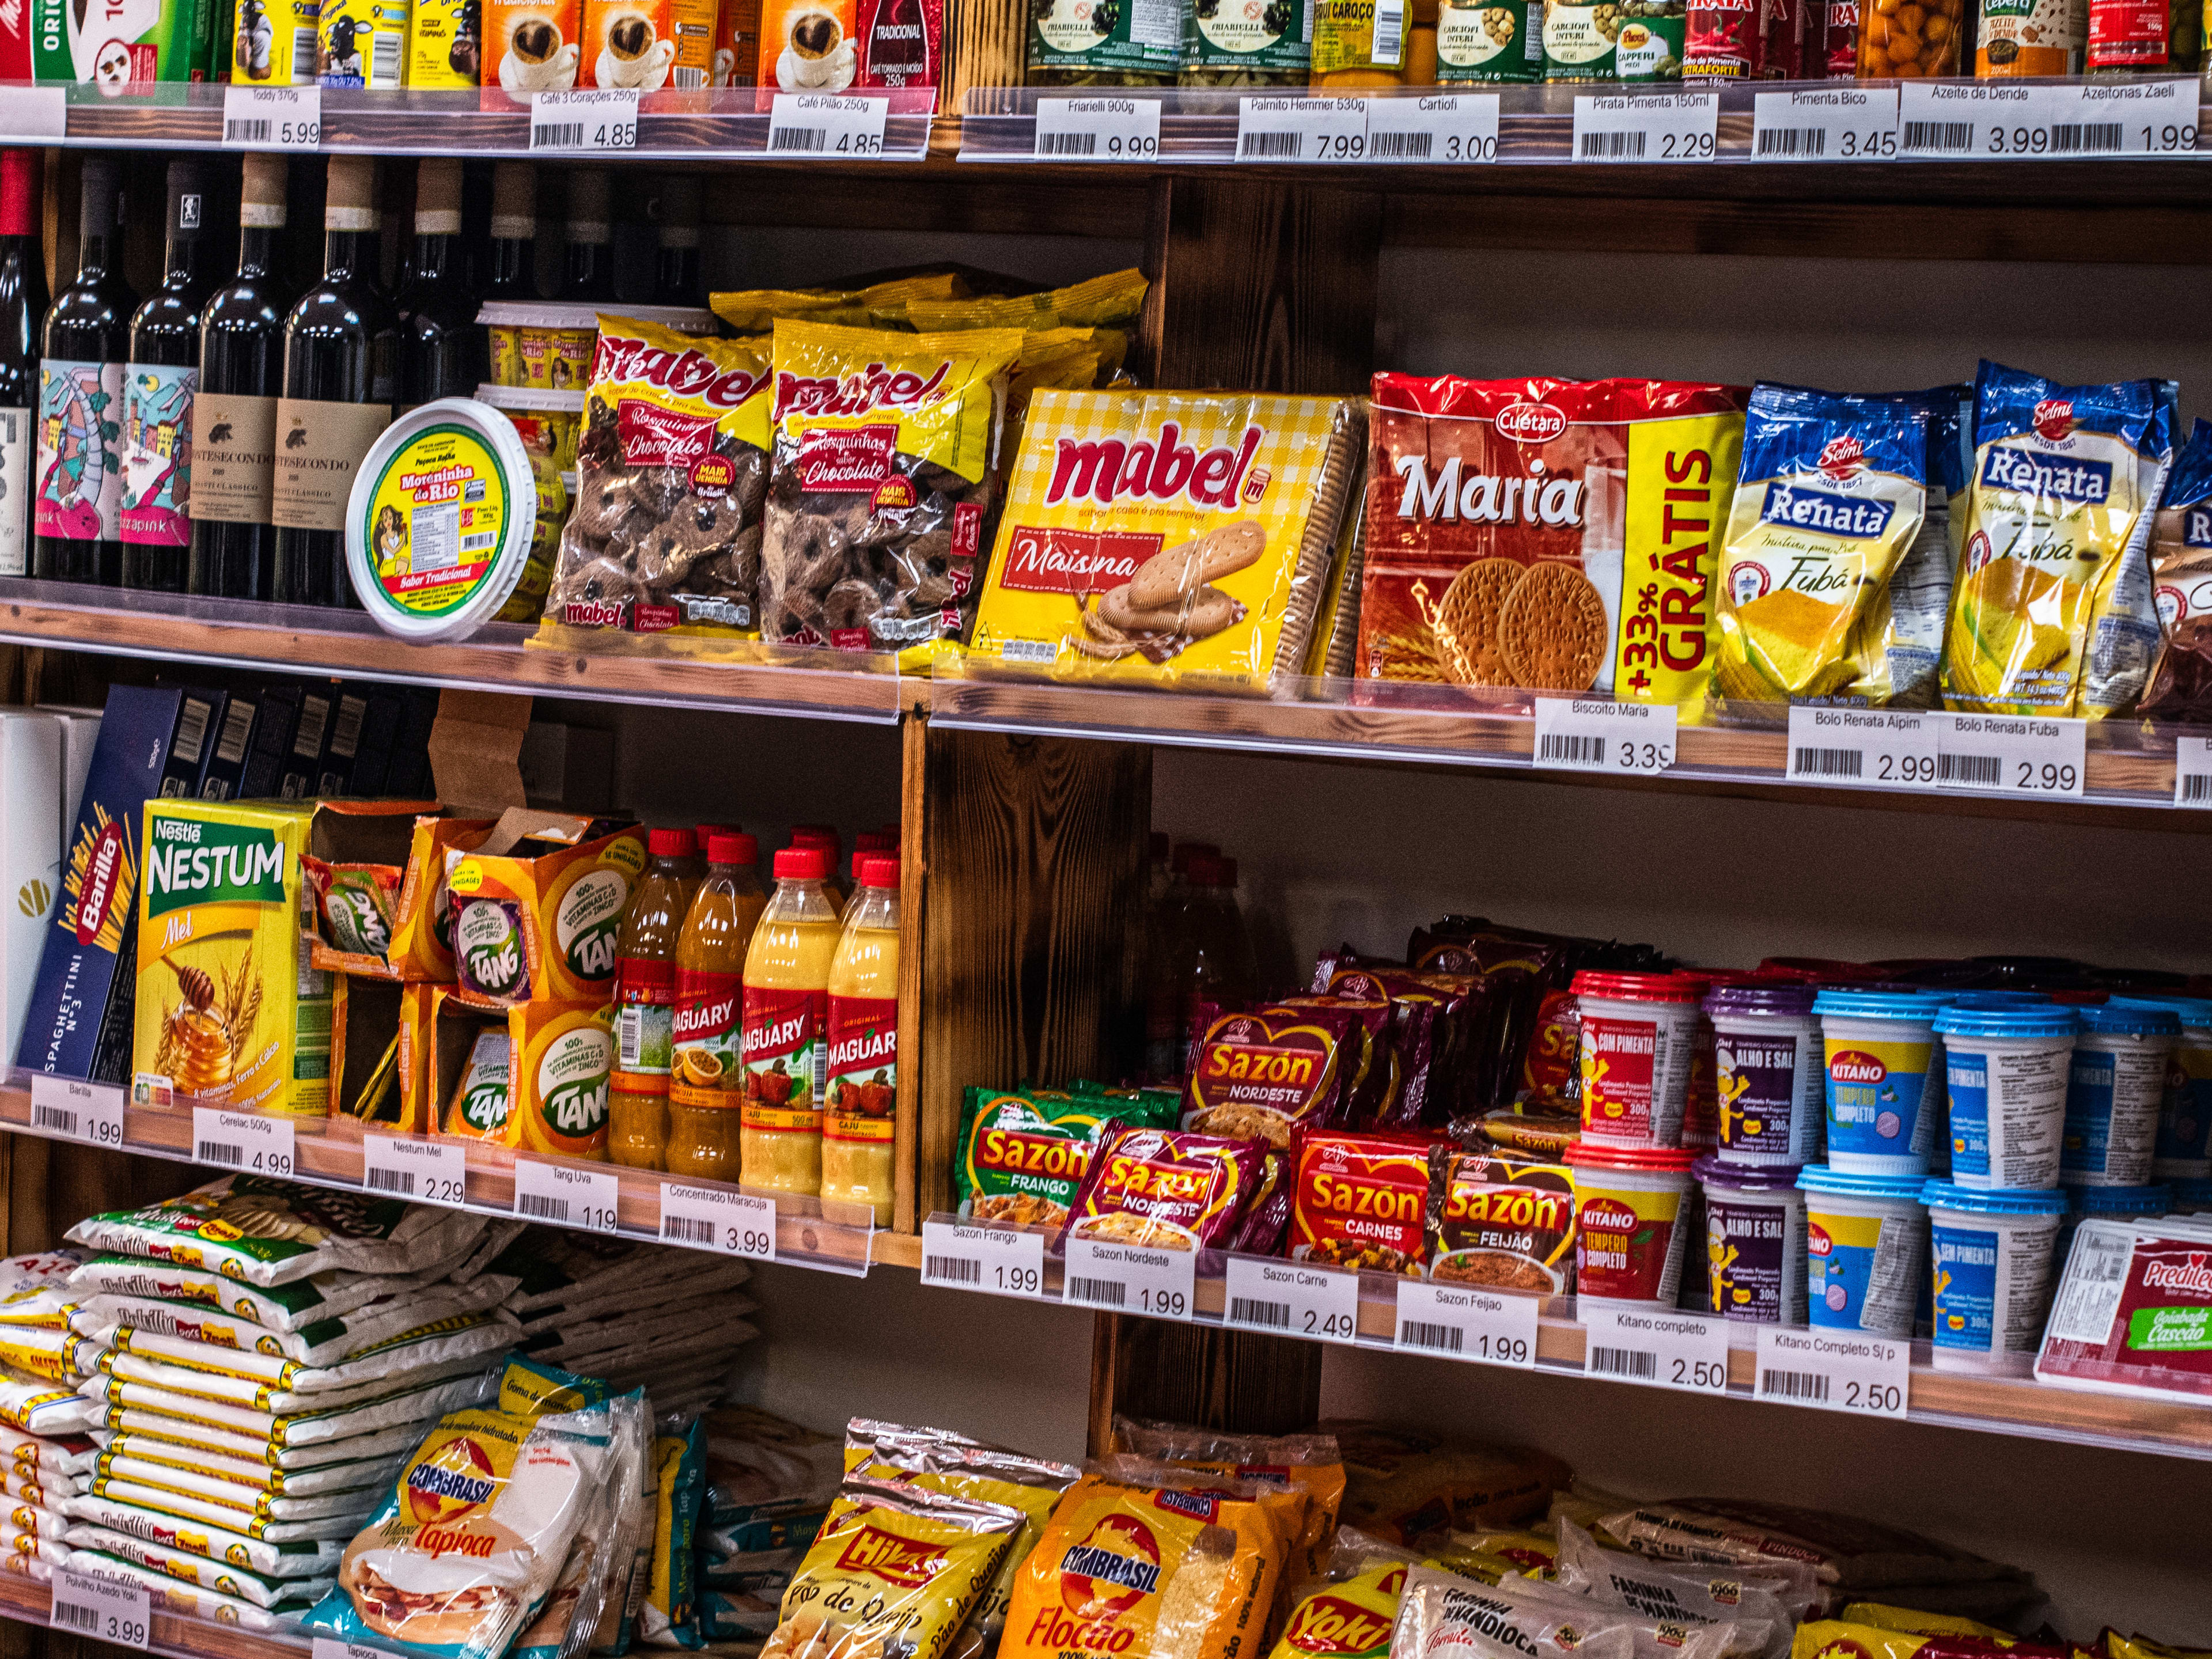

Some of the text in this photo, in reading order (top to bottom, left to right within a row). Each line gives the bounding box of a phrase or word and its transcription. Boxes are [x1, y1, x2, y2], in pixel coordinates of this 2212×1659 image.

[1332, 3, 1373, 20] CAROÇO
[876, 25, 921, 40] TRADICIONAL
[1708, 56, 1741, 65] Pimenta
[886, 75, 905, 88] 250g
[1932, 86, 2028, 100] Azeite de Dende
[2082, 84, 2174, 100] Azeitonas Zaeli
[253, 89, 298, 103] Toddy 370g
[540, 91, 636, 105] Café 3 Corações 250g
[798, 96, 868, 112] Café Pilão 250g
[1069, 101, 1134, 114] Friarielli 900g
[1252, 98, 1364, 112] Palmito Hemmer 530g
[1419, 97, 1457, 111] Cartiofi
[1594, 94, 1709, 110] Pirata Pimenta 150ml
[1792, 92, 1866, 105] Pimenta Bico
[282, 123, 319, 143] 5.99
[594, 124, 635, 146] 4.85
[836, 134, 881, 154] 4.85
[1841, 132, 1896, 157] 3.45
[1988, 127, 2047, 153] 3.99
[2141, 126, 2197, 151] 1.99
[1317, 135, 1364, 158] 7.99
[1446, 136, 1497, 160] 3.00
[1661, 133, 1714, 158] 2.29
[773, 360, 956, 426] mabel
[1499, 411, 1560, 433] Cuétara
[2032, 402, 2074, 426] Selmi
[699, 465, 726, 476] MAIS
[806, 460, 885, 484] Chocolate
[1046, 421, 1265, 512] mabel
[1987, 452, 2103, 499] Renata
[400, 465, 473, 502] Moreninha do Rio
[695, 475, 728, 485] VENDIDA
[1396, 454, 1586, 525] Maria
[1150, 509, 1164, 517] pra
[1166, 510, 1205, 521] sempre!
[1766, 490, 1885, 533] Renata
[1647, 449, 1713, 672] GRÁTIS
[400, 565, 471, 588] Sabor Tradicional
[1780, 556, 1849, 592] Fubá
[565, 601, 626, 628] mabel
[1624, 584, 1658, 696] +33%
[1573, 700, 1648, 717] Biscoito Maria
[1816, 712, 1920, 730] Bolo Renata Aipim
[1956, 718, 2059, 737] Bolo Renata Fuba
[1878, 755, 1934, 782] 2.99
[2018, 763, 2076, 790] 2.99
[156, 820, 202, 842] Nestlé
[147, 842, 284, 895] NESTUM
[82, 836, 118, 931] Barilla
[161, 912, 194, 949] Mel
[471, 942, 517, 988] TANG
[46, 954, 82, 1072] SPAGHETTINI
[844, 1016, 880, 1027] ORIGINAL
[828, 1030, 898, 1069] MAGUAR
[1599, 1033, 1653, 1055] COM PIMENTA
[1208, 1044, 1312, 1084] Sazón
[1736, 1049, 1793, 1069] ALHO E SAL
[194, 1062, 260, 1099] 8 vitaminas, Ferro e
[1832, 1065, 1882, 1080] KITANO
[69, 1084, 91, 1098] Barilla
[1230, 1085, 1303, 1103] NORDESTE
[88, 1122, 120, 1145] 1.99
[220, 1114, 271, 1134] Cerelac 500g
[393, 1141, 441, 1158] Nestum Mel
[983, 1131, 1088, 1177] Sazón
[252, 1152, 290, 1175] 4.99
[553, 1168, 591, 1184] Tang Uva
[1010, 1174, 1069, 1195] FRANGO
[1104, 1157, 1210, 1199] Sazón
[426, 1177, 464, 1202] 2.29
[669, 1184, 767, 1211] Concentrado Maracuja
[1312, 1173, 1419, 1222] Sazón
[1446, 1182, 1558, 1229] Sazón
[582, 1207, 616, 1232] 1.19
[1345, 1219, 1403, 1241] CARNES
[1583, 1209, 1633, 1228] KITANO
[1727, 1218, 1783, 1238] ALHO E SAL
[726, 1228, 769, 1254] 3.99
[953, 1226, 1017, 1244] Sazon Frango
[1480, 1231, 1532, 1251] FEIJÃO
[1586, 1232, 1627, 1252] TEMPERO
[1093, 1246, 1169, 1267] Sazon Nordeste
[1587, 1251, 1626, 1269] COMPLETO
[1941, 1243, 1955, 1262] SEM
[994, 1267, 1037, 1291] 1.99
[1263, 1268, 1327, 1288] Sazon Carne
[1140, 1290, 1184, 1315] 1.99
[1436, 1291, 1502, 1311] Sazon Feijao
[1304, 1310, 1353, 1338] 2.49
[1618, 1314, 1706, 1336] Kitano completo
[2147, 1325, 2205, 1343] Cascão
[1478, 1335, 1527, 1363] 1.99
[1775, 1335, 1895, 1360] Kitano Completo S/ p
[1672, 1359, 1725, 1388] 2.50
[1844, 1382, 1900, 1411] 2.50
[408, 1463, 495, 1504] COMBRASIL
[415, 1522, 497, 1558] Tapioca
[1061, 1545, 1161, 1594] COMBRASIL
[65, 1573, 137, 1603] Polvilho Azedo Yoki
[930, 1542, 1009, 1656] Pão de Queijo
[108, 1616, 144, 1644] 3.99
[1027, 1606, 1135, 1653] Flocão
[1293, 1601, 1392, 1650] Yoki
